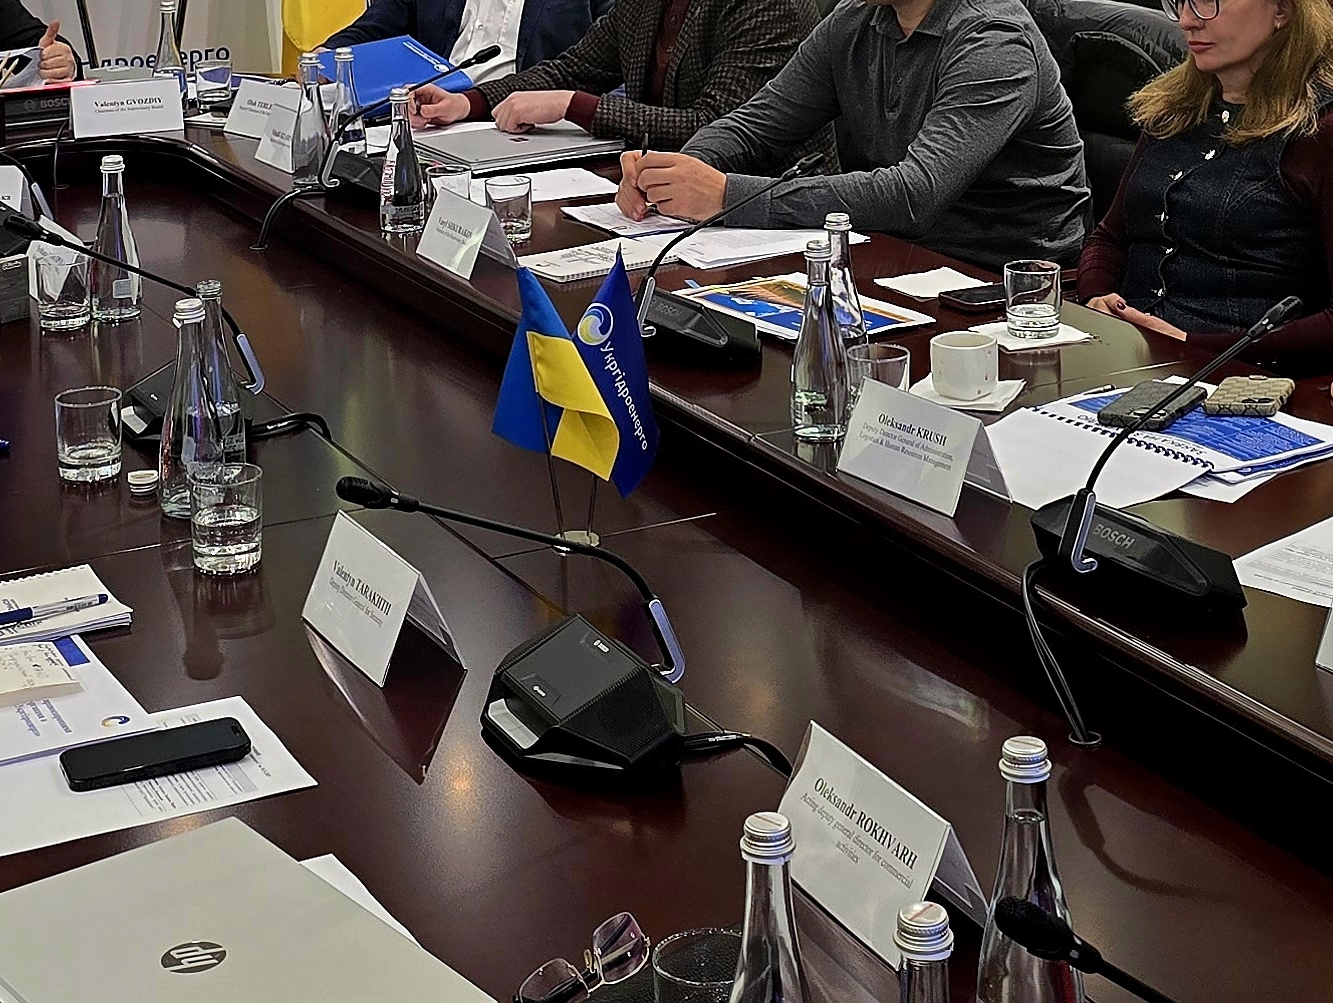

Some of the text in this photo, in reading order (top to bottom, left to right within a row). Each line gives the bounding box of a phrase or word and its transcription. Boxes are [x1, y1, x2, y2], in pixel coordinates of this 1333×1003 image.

[40, 97, 69, 109] BOSC
[600, 341, 648, 451] Укргідроенерго
[878, 413, 948, 447] Oleksandr KRUSH
[1092, 523, 1136, 549] BOSCH
[814, 777, 918, 871] Oleksandr ROKHVARH
